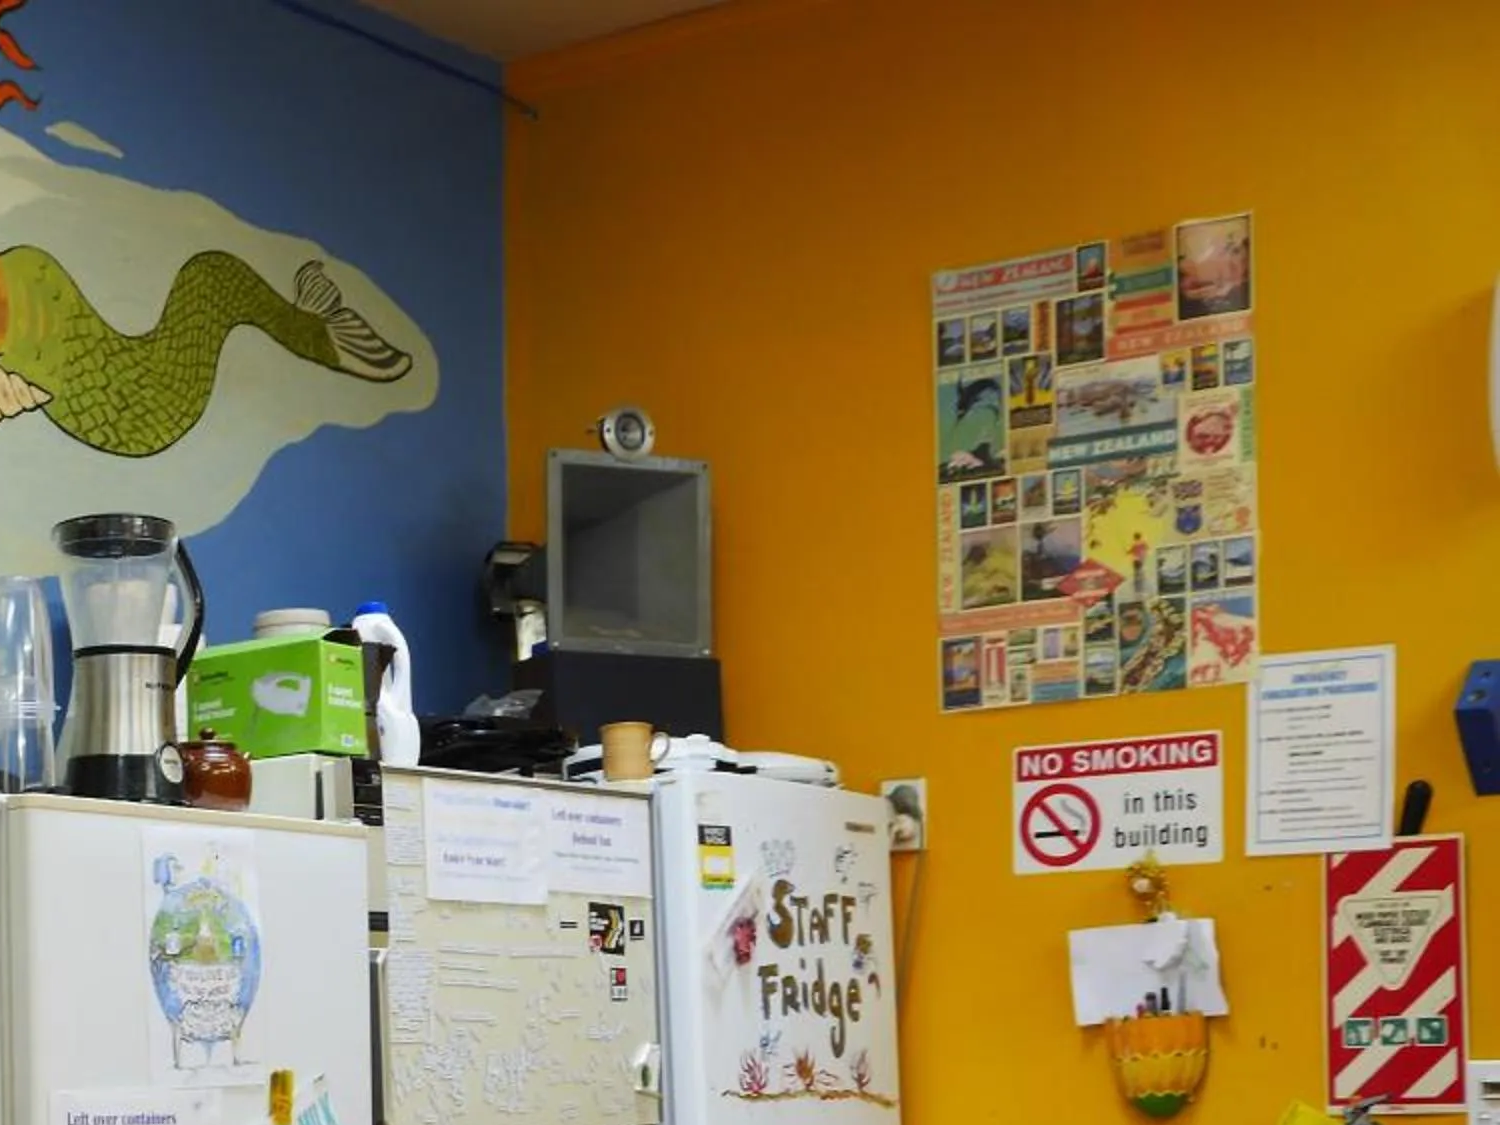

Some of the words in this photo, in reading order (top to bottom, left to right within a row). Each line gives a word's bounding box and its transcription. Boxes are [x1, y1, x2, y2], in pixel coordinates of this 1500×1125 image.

[1021, 753, 1063, 777] NO
[1071, 739, 1213, 773] SMOKING
[1124, 792, 1145, 814] in
[1154, 789, 1198, 812] this
[1114, 822, 1209, 848] building
[766, 878, 857, 949] STAFF
[120, 1112, 178, 1125] containers
